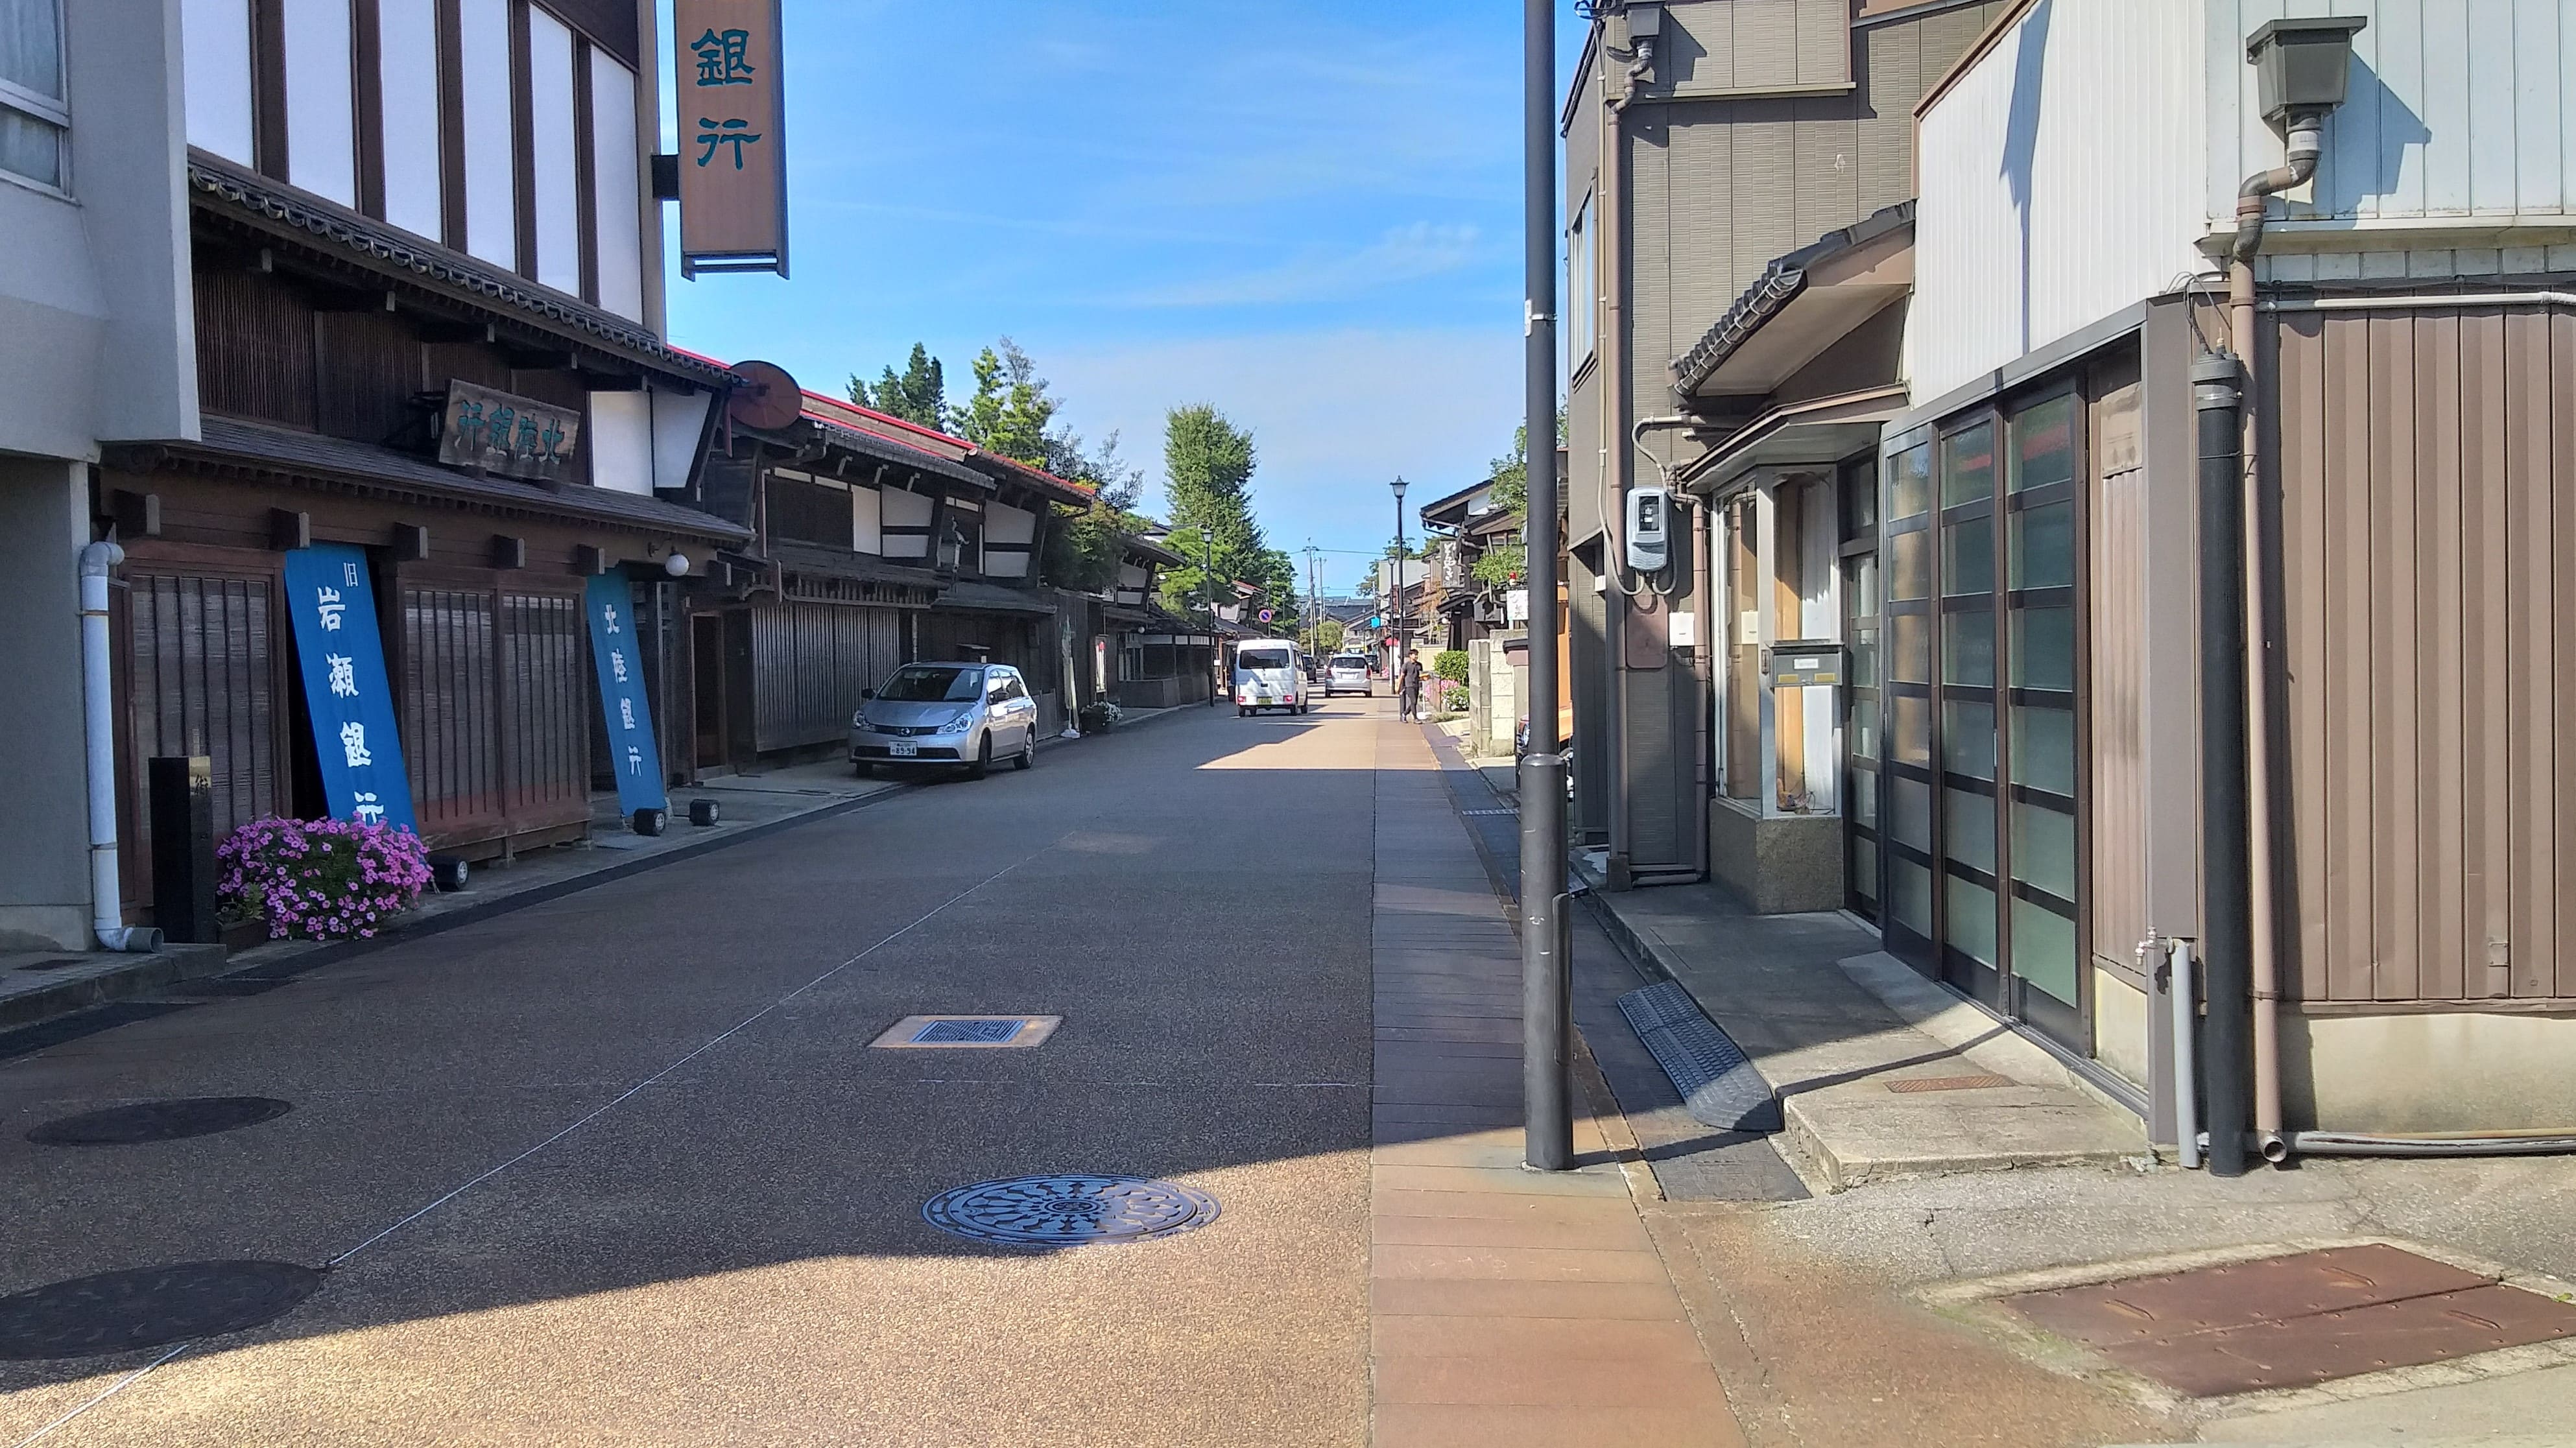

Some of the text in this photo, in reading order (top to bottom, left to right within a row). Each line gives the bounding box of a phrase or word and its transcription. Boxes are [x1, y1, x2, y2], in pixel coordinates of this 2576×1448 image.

[691, 28, 762, 171] 銀行
[604, 603, 642, 777] 北陸銀行
